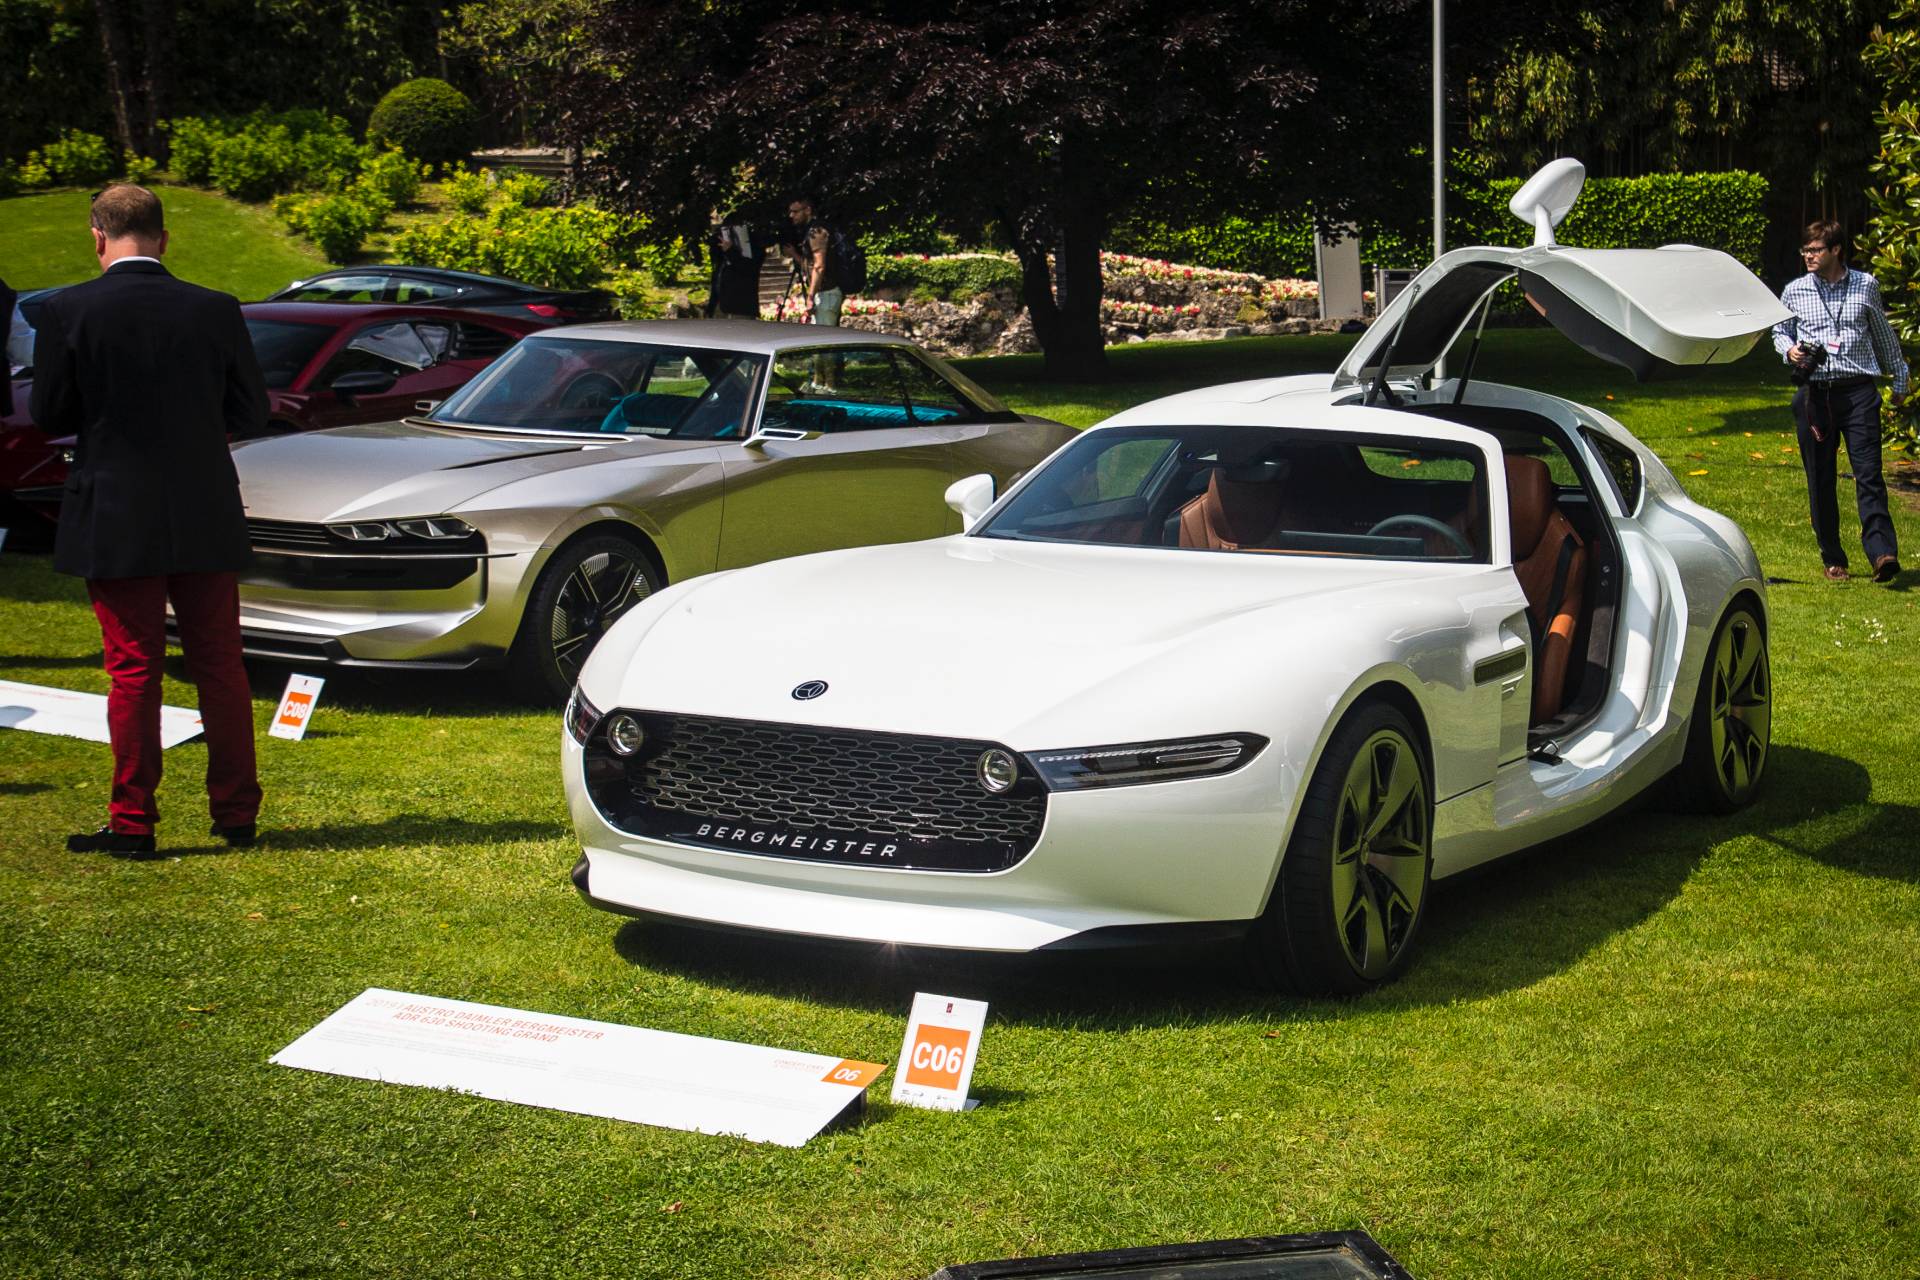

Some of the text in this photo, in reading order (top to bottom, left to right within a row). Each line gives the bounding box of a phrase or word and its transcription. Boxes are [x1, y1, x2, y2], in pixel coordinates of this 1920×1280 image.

[696, 824, 898, 857] BERGMEISTER
[393, 1012, 420, 1022] ADR
[445, 1020, 510, 1036] SHOOTING
[512, 1030, 559, 1042] GRAND
[403, 1004, 454, 1017] AUSTRO
[455, 1011, 512, 1025] DAIMLER
[512, 1020, 604, 1040] BERGMEISTER
[913, 1041, 963, 1074] C06
[834, 1068, 861, 1081] 06
